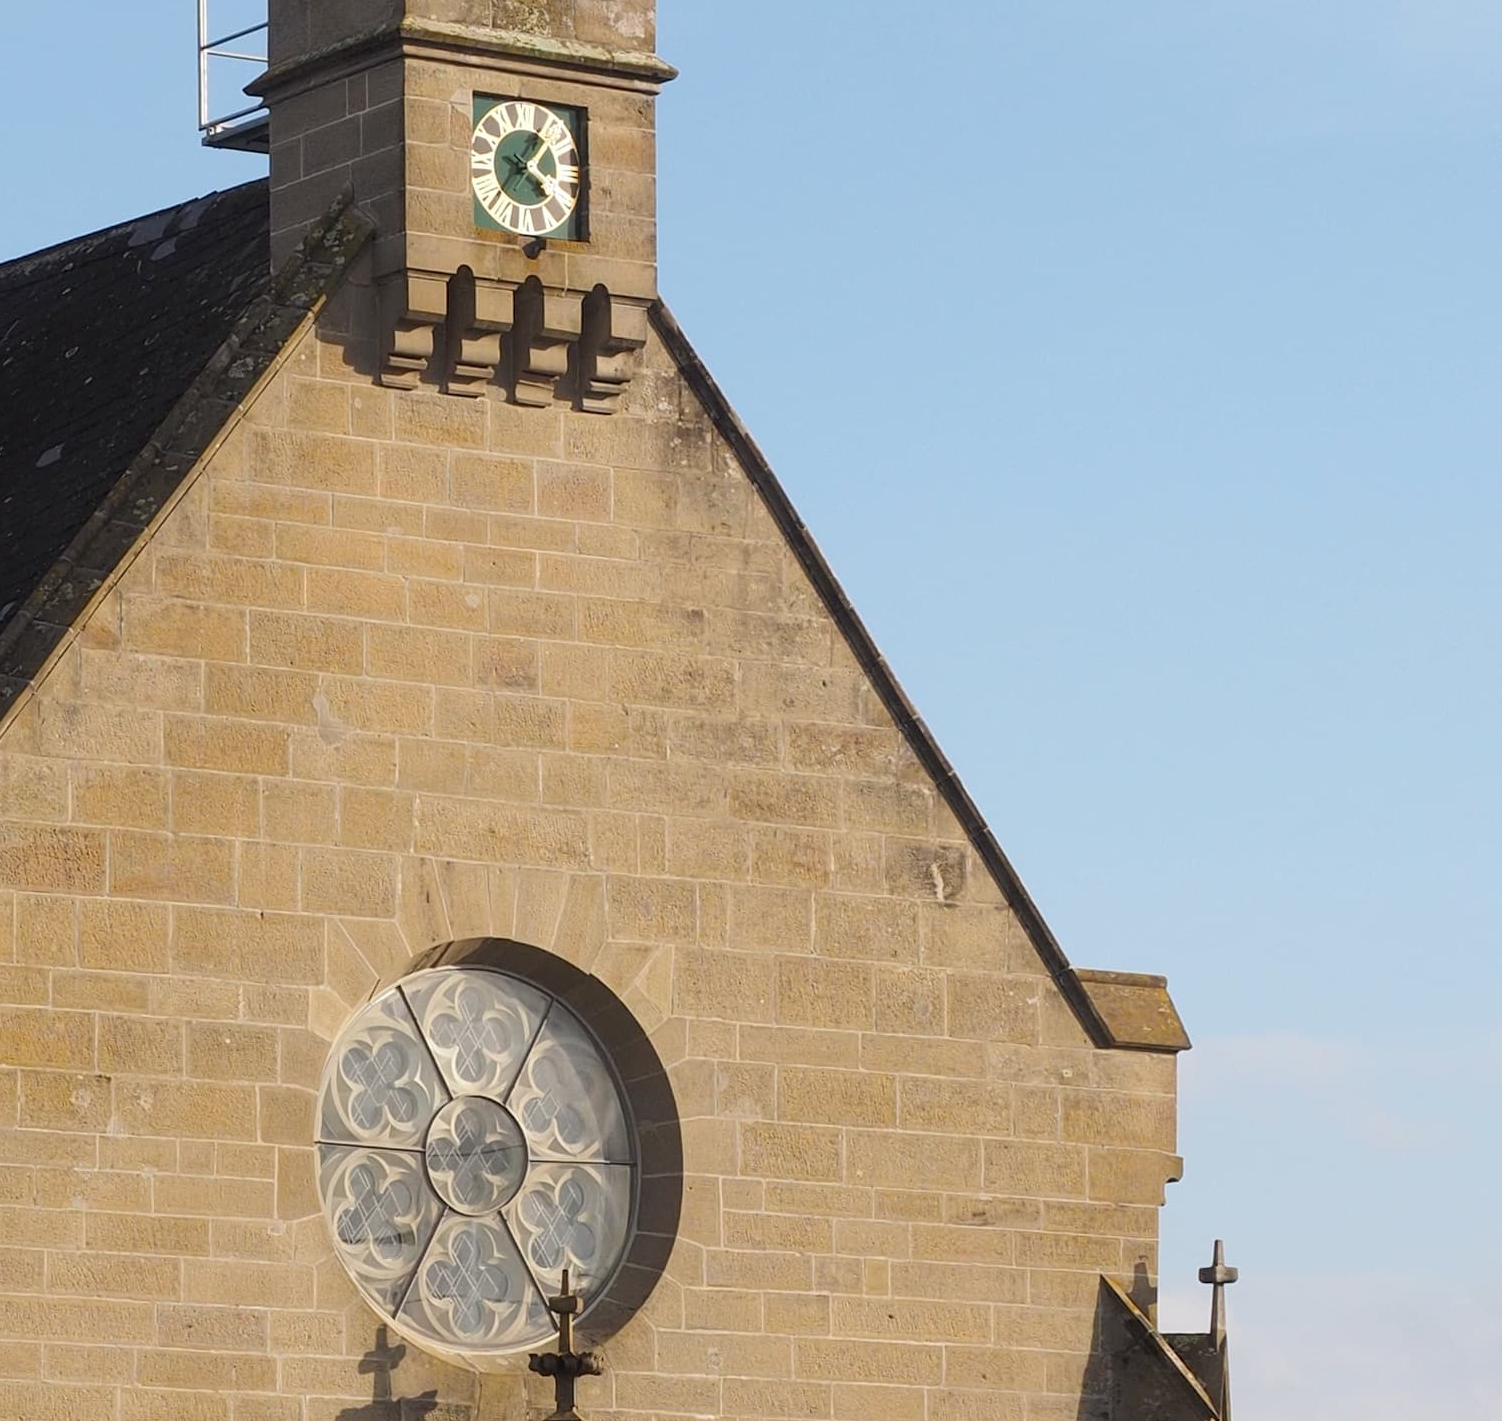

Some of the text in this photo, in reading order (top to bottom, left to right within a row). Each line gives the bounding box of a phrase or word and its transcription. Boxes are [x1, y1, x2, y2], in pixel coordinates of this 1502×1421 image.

[491, 106, 512, 133] XI
[514, 103, 535, 130] XII
[476, 124, 500, 145] X
[472, 151, 493, 169] IX
[558, 164, 579, 183] III
[472, 172, 501, 202] VIII
[491, 192, 512, 225] VII
[518, 206, 535, 232] VI
[542, 204, 560, 225] V
